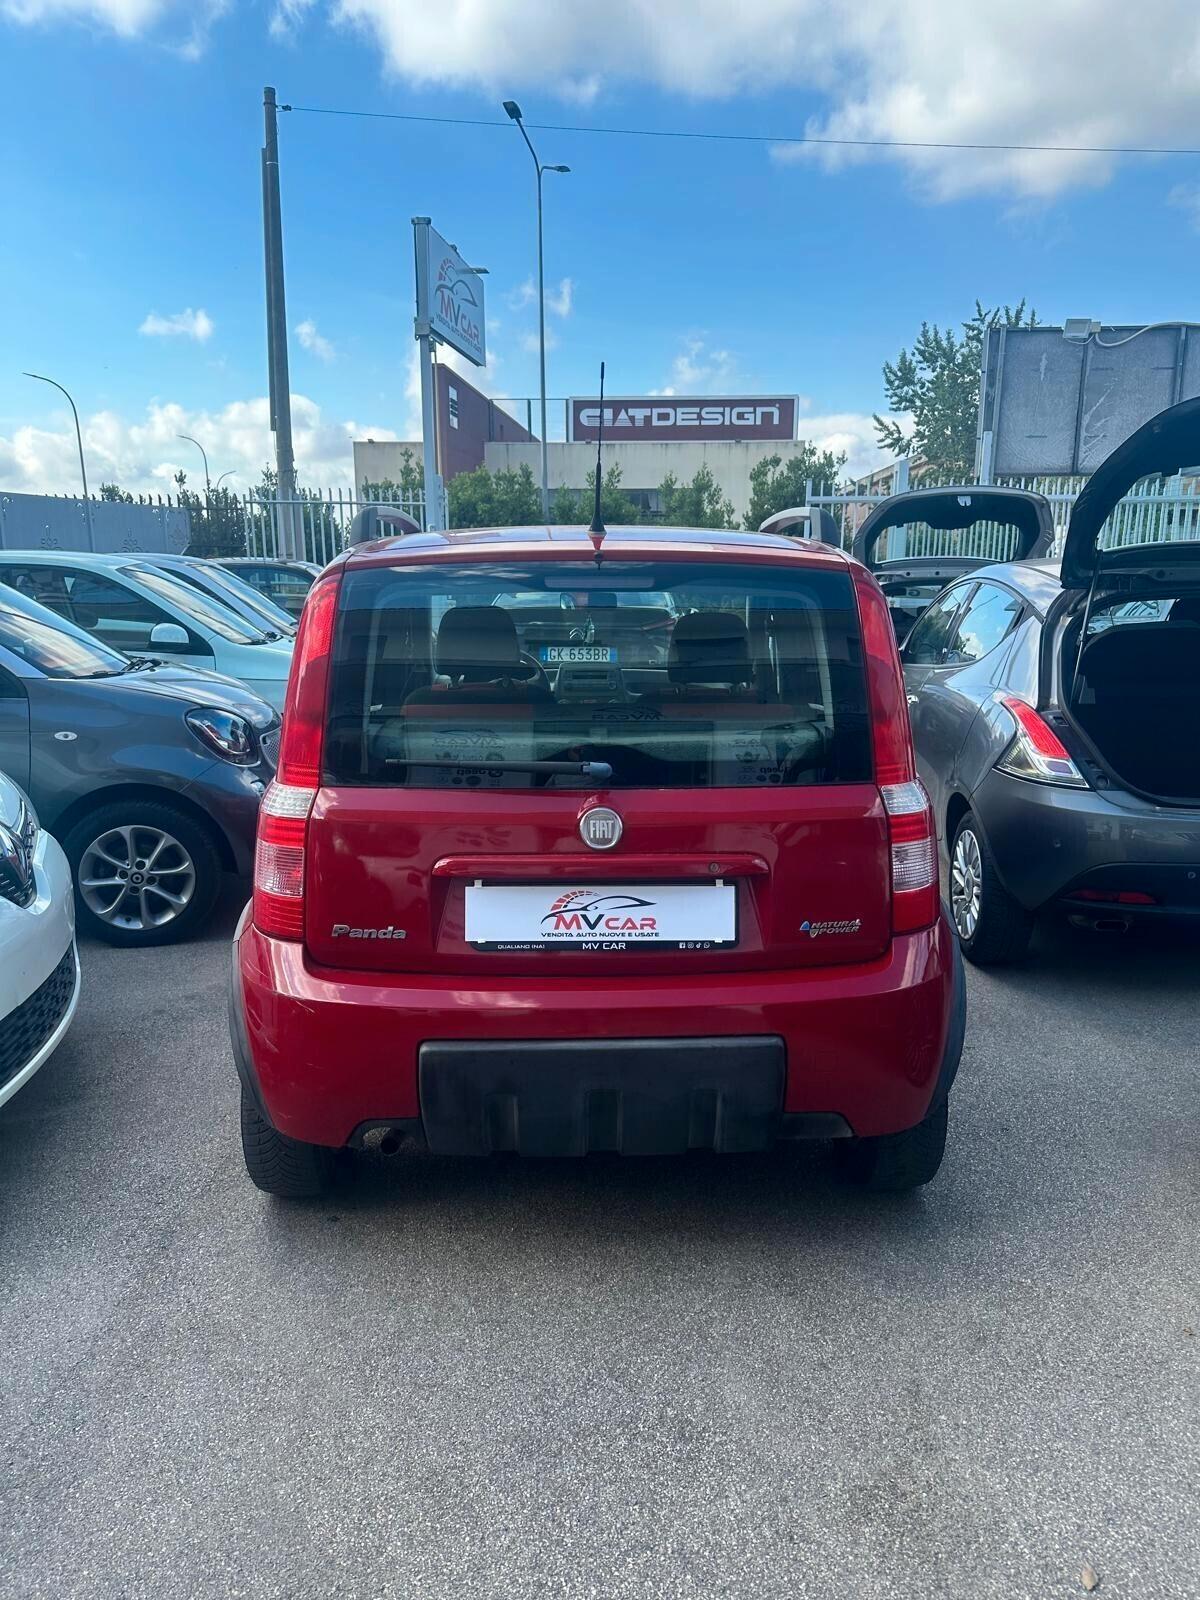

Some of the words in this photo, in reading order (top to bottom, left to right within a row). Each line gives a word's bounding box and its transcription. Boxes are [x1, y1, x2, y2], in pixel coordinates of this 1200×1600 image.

[589, 819, 614, 839] FIAT
[810, 918, 862, 929] NATURAL
[331, 924, 407, 939] Panda
[818, 926, 860, 935] POWER
[582, 942, 600, 950] MV
[602, 942, 627, 950] CAR
